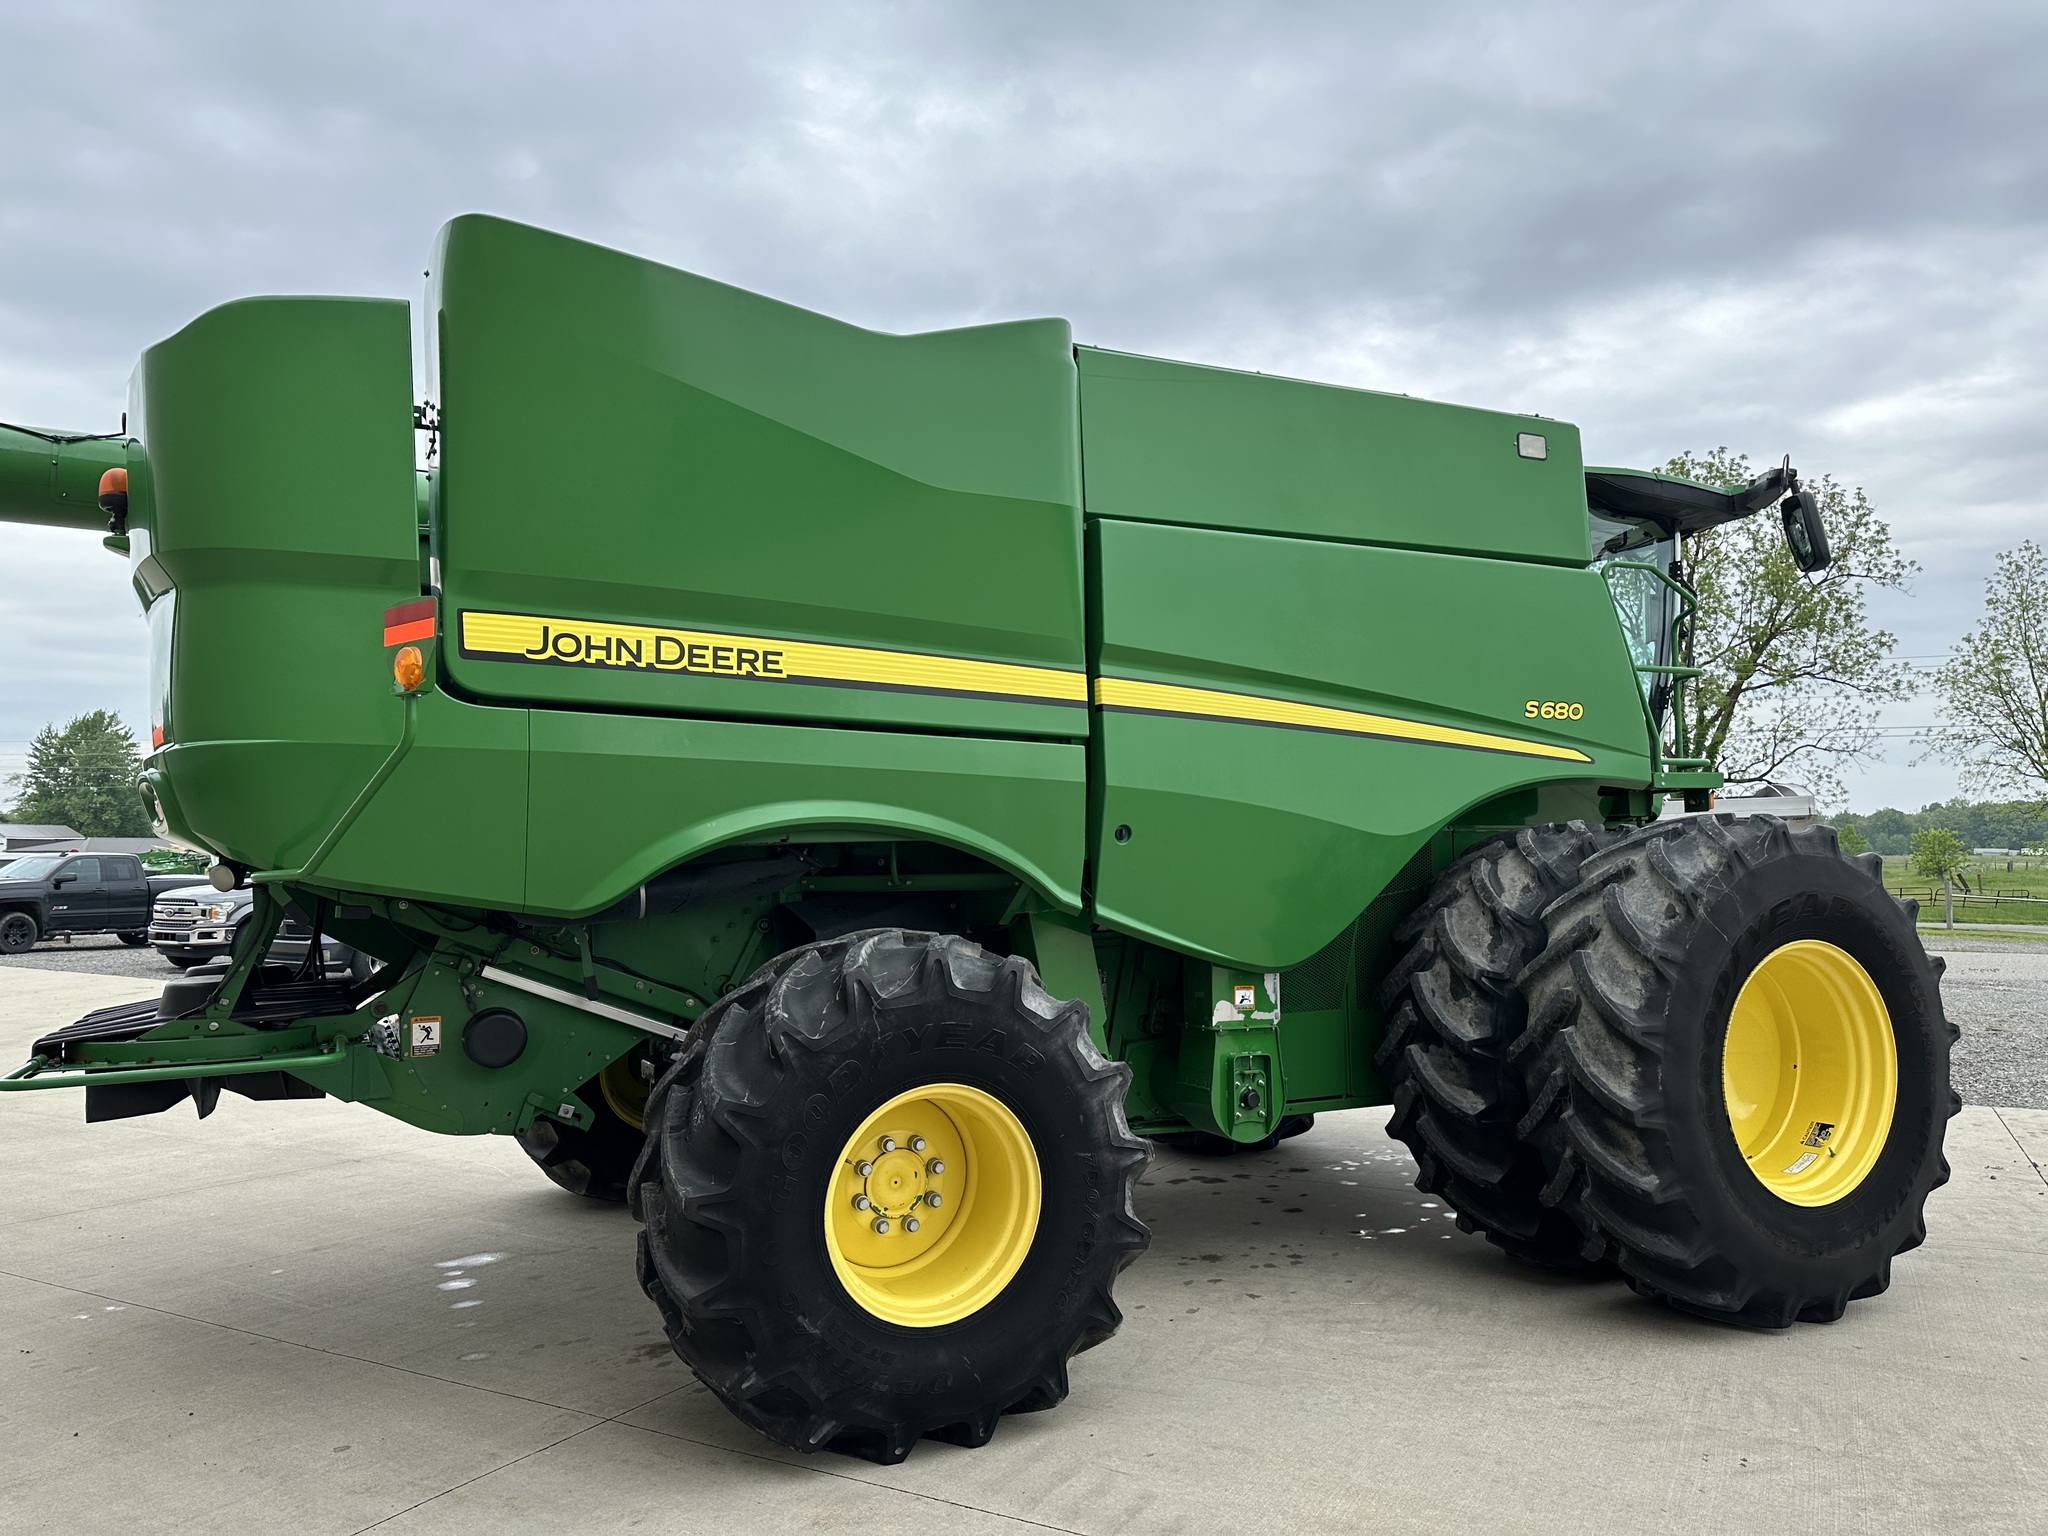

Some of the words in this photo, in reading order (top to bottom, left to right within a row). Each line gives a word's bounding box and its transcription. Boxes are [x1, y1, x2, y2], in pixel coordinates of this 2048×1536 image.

[525, 625, 644, 664] JOHN
[654, 635, 785, 675] DEERE
[1524, 700, 1584, 720] S680
